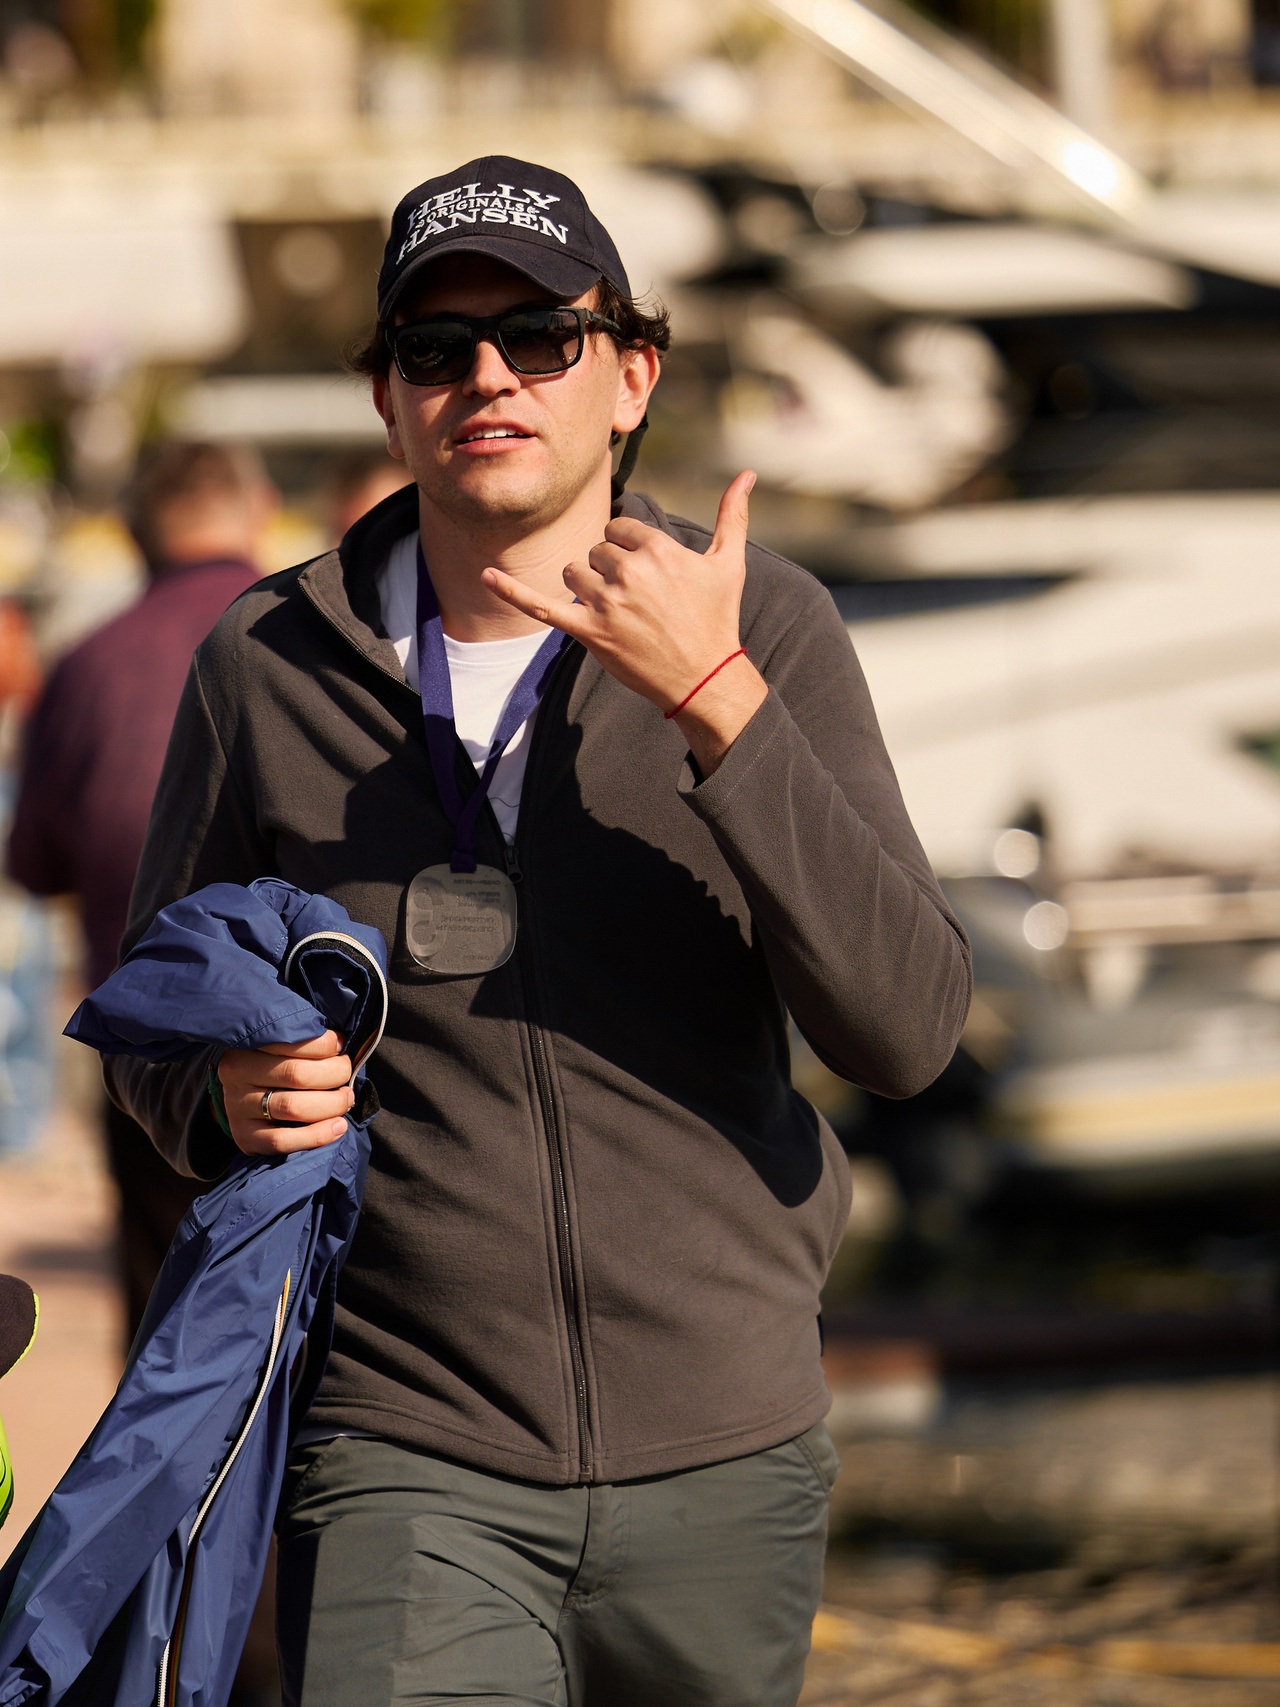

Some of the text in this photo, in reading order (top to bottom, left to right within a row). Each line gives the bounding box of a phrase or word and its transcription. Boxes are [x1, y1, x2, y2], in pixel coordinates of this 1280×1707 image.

[407, 182, 561, 234] HELLY
[426, 197, 525, 223] ORIGINALS
[396, 208, 569, 266] HANSEN
